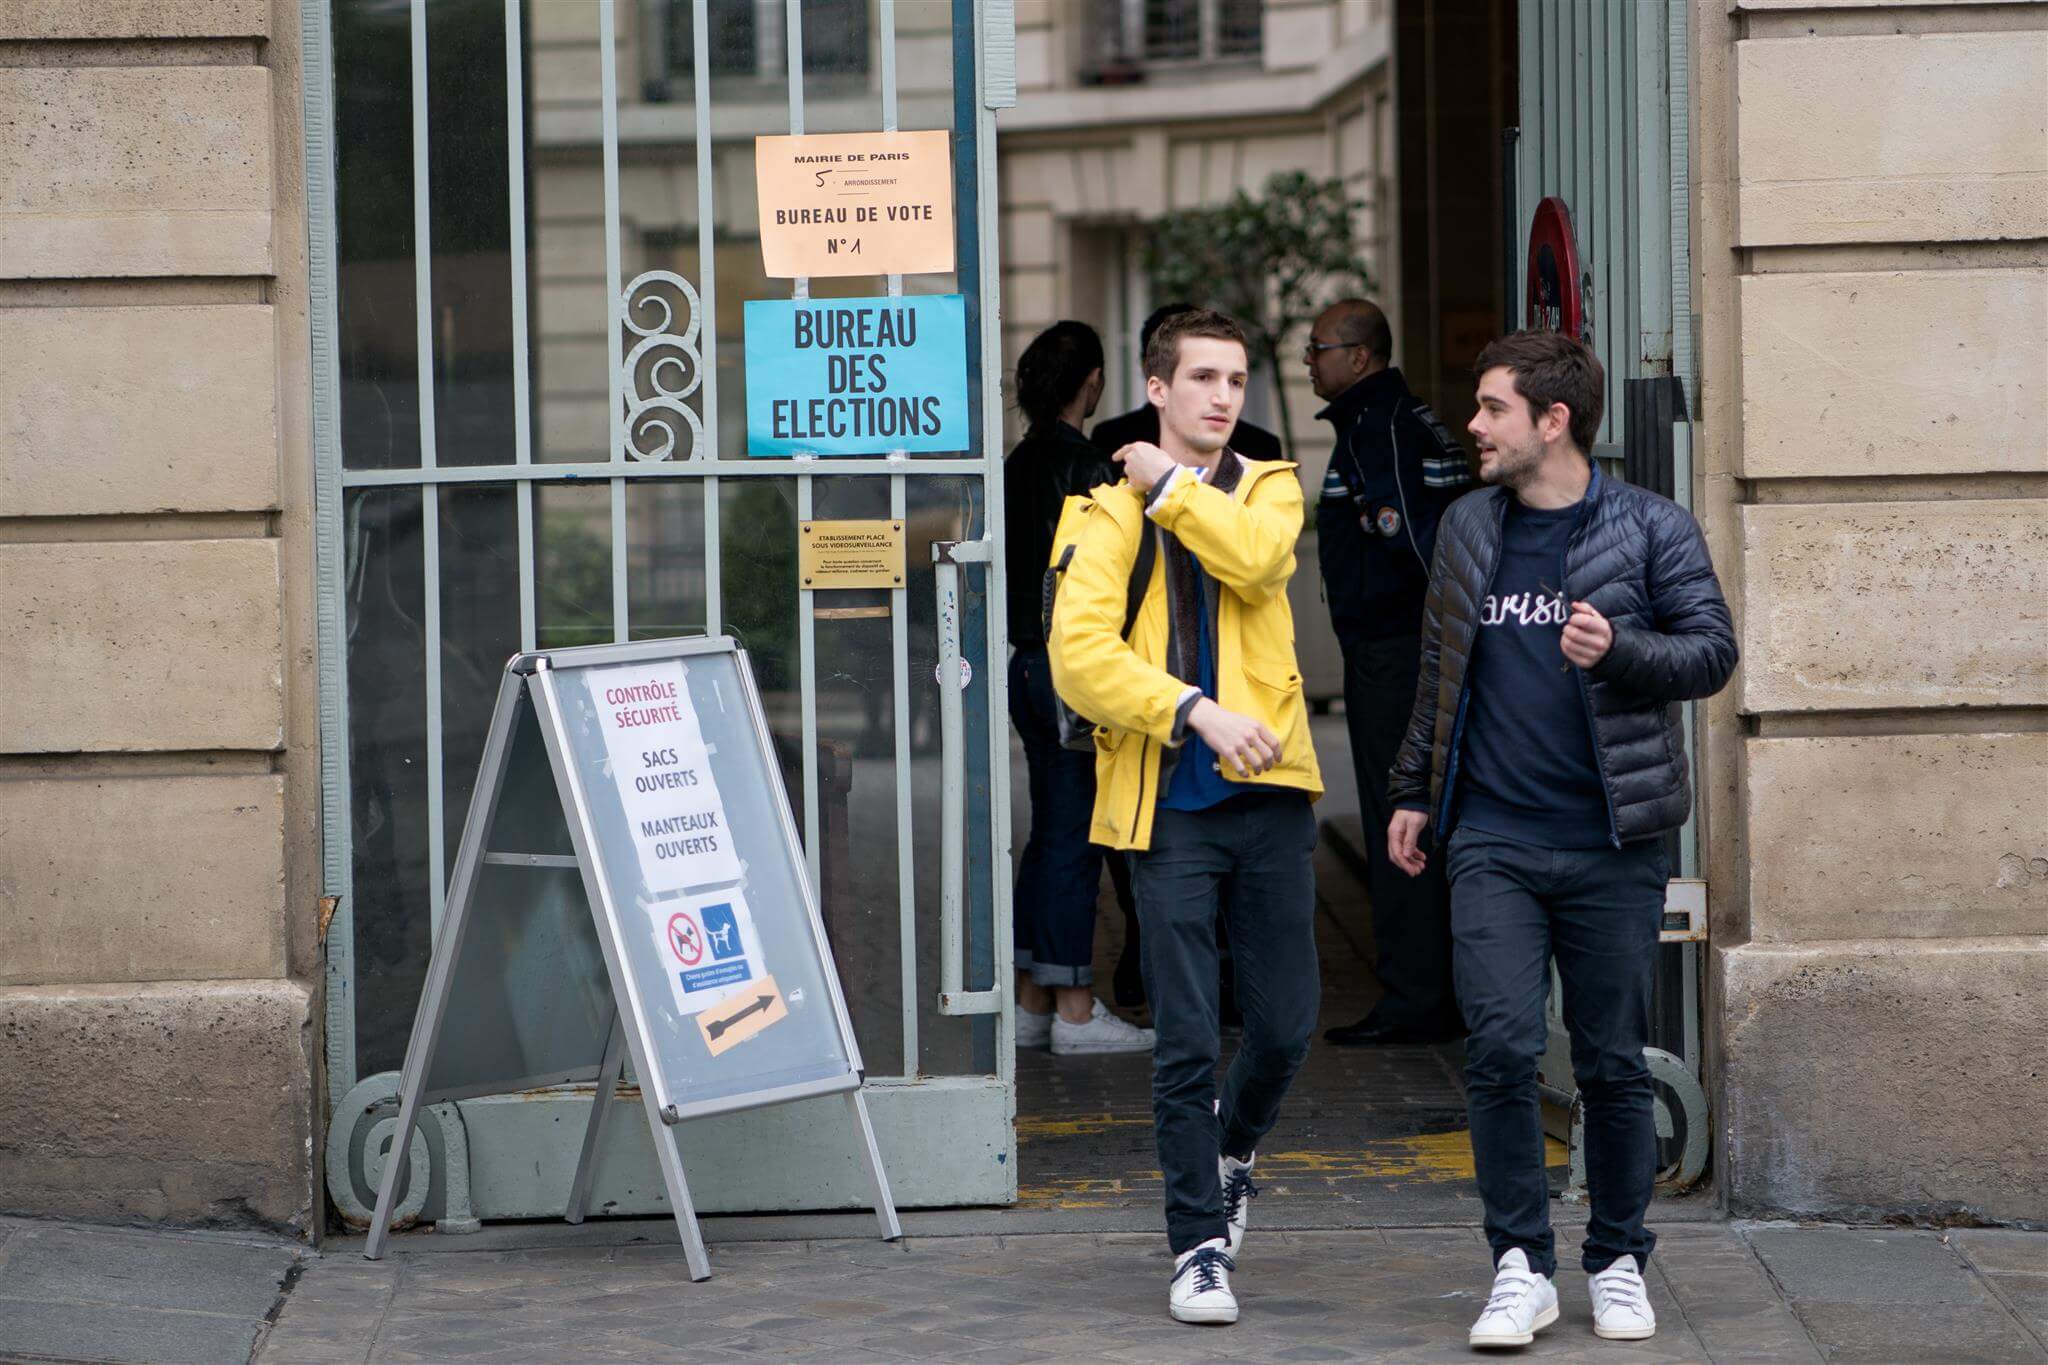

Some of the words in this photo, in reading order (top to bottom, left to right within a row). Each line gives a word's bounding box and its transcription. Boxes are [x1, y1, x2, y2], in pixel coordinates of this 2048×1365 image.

[794, 155, 842, 164] MAIRIE
[847, 154, 865, 162] DE
[870, 153, 910, 161] PARIS
[844, 178, 897, 186] ARRONDISSEMENT
[776, 208, 847, 225] BUREAU
[856, 207, 877, 222] DE
[887, 205, 933, 221] VOTE
[794, 308, 916, 349] BUREAU
[828, 354, 887, 394] DES
[772, 396, 941, 439] ELECTIONS
[1480, 591, 1567, 625] arisi
[606, 679, 678, 705] CONTRÔLE
[616, 701, 682, 729] SÉCURITÉ
[642, 748, 679, 768] SACS
[635, 769, 698, 793] OUVERTS
[641, 811, 719, 838] MANTEAUX
[655, 835, 718, 860] OUVERTS
